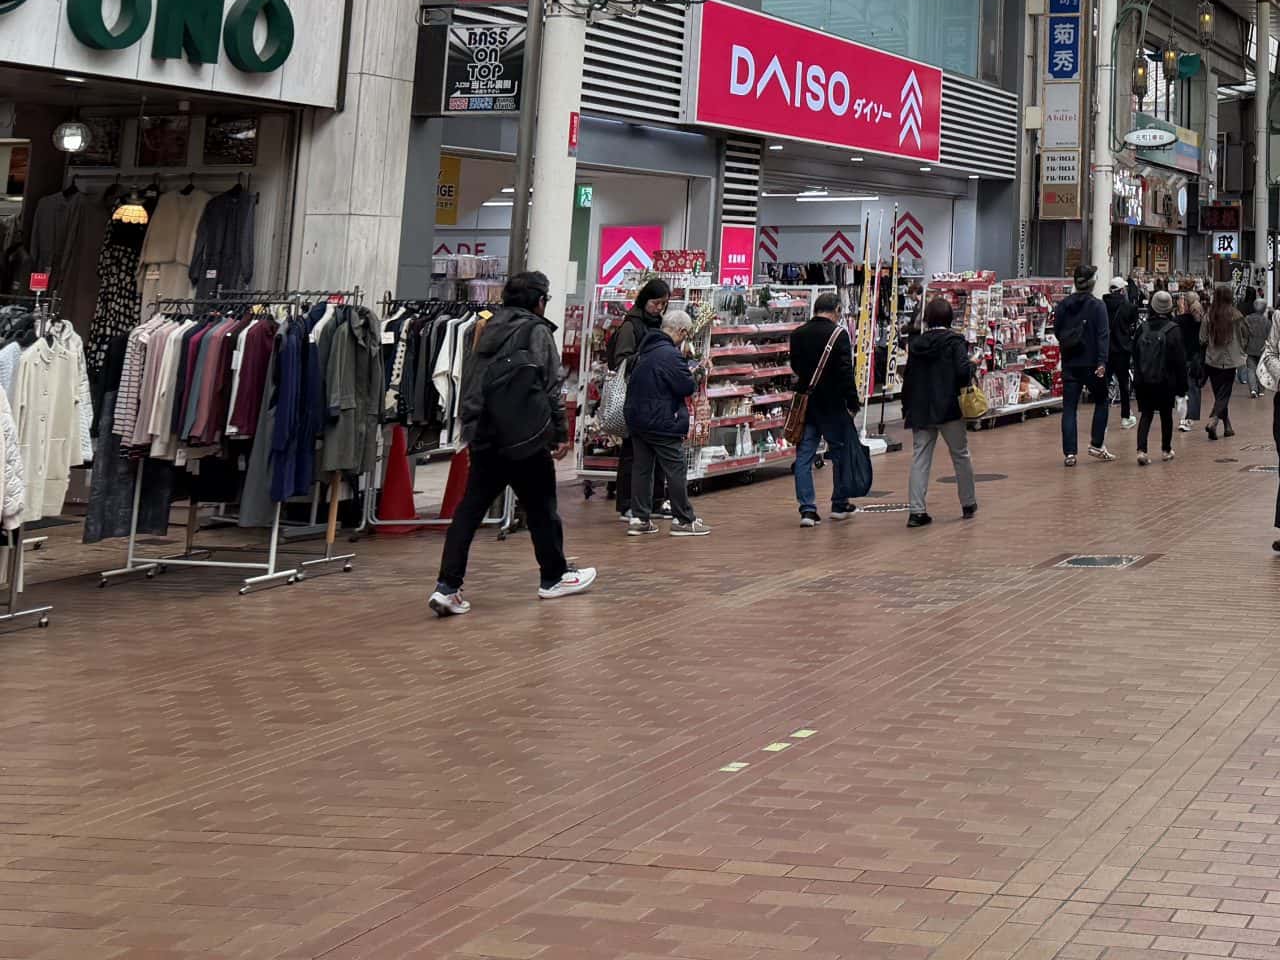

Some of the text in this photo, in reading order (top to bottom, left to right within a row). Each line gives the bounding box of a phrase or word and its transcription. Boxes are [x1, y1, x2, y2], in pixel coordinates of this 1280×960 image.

[467, 31, 509, 47] BASS
[1053, 23, 1075, 72] 菊秀
[467, 63, 504, 81] TOP
[729, 43, 851, 117] DAISO
[853, 97, 893, 124] ダイソー
[1217, 235, 1234, 251] 取
